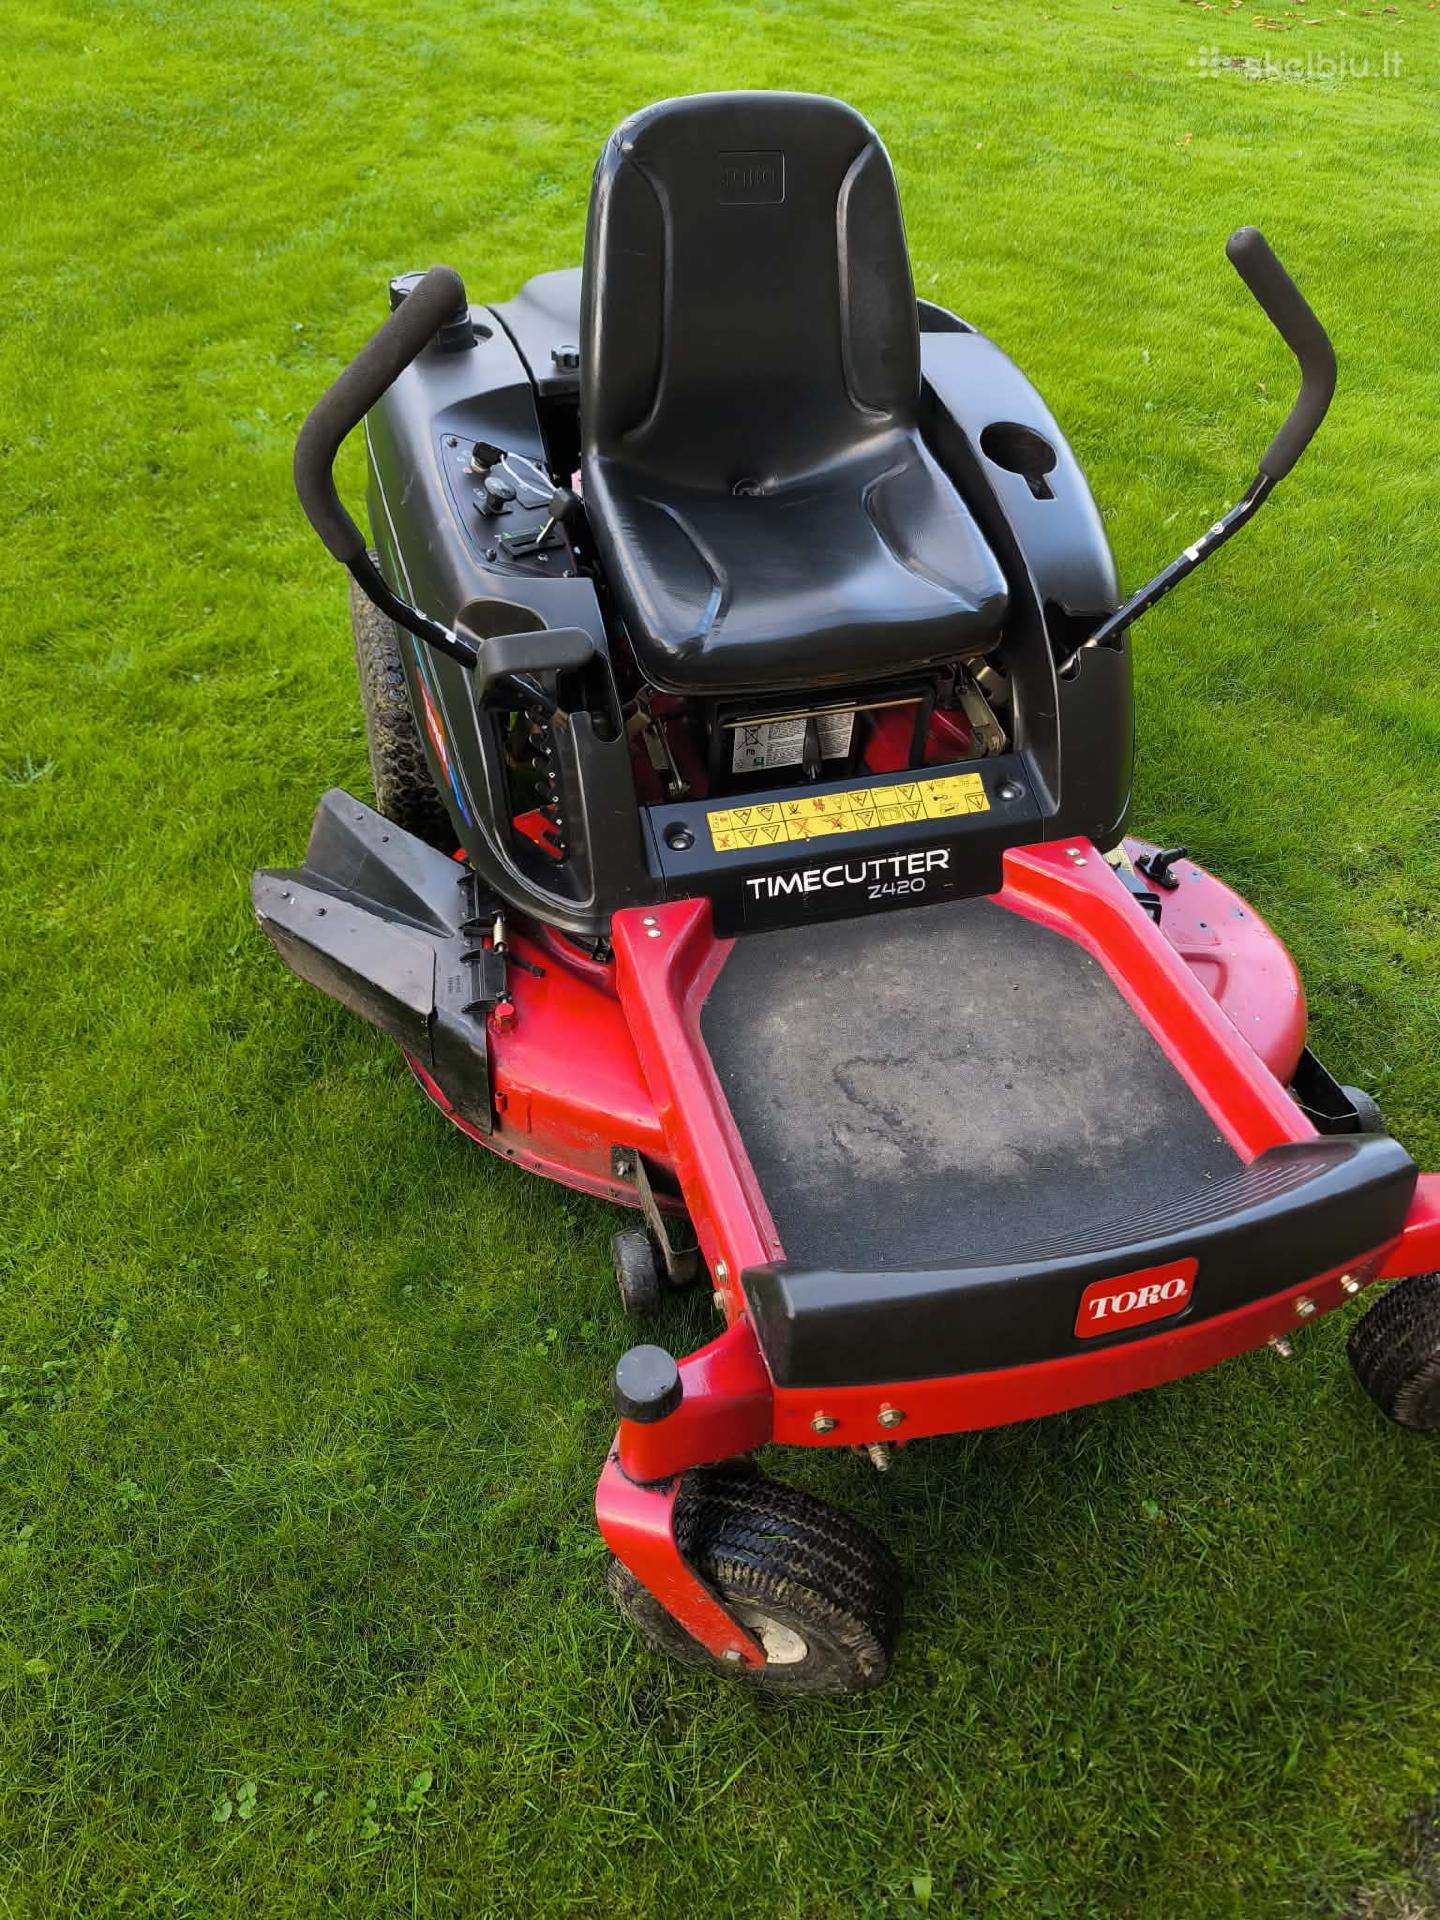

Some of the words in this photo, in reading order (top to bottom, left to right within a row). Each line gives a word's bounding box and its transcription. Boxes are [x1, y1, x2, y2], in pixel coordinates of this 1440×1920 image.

[746, 848, 950, 900] TIMECUTTER
[867, 877, 926, 900] Z420
[1088, 1278, 1187, 1320] TORO
